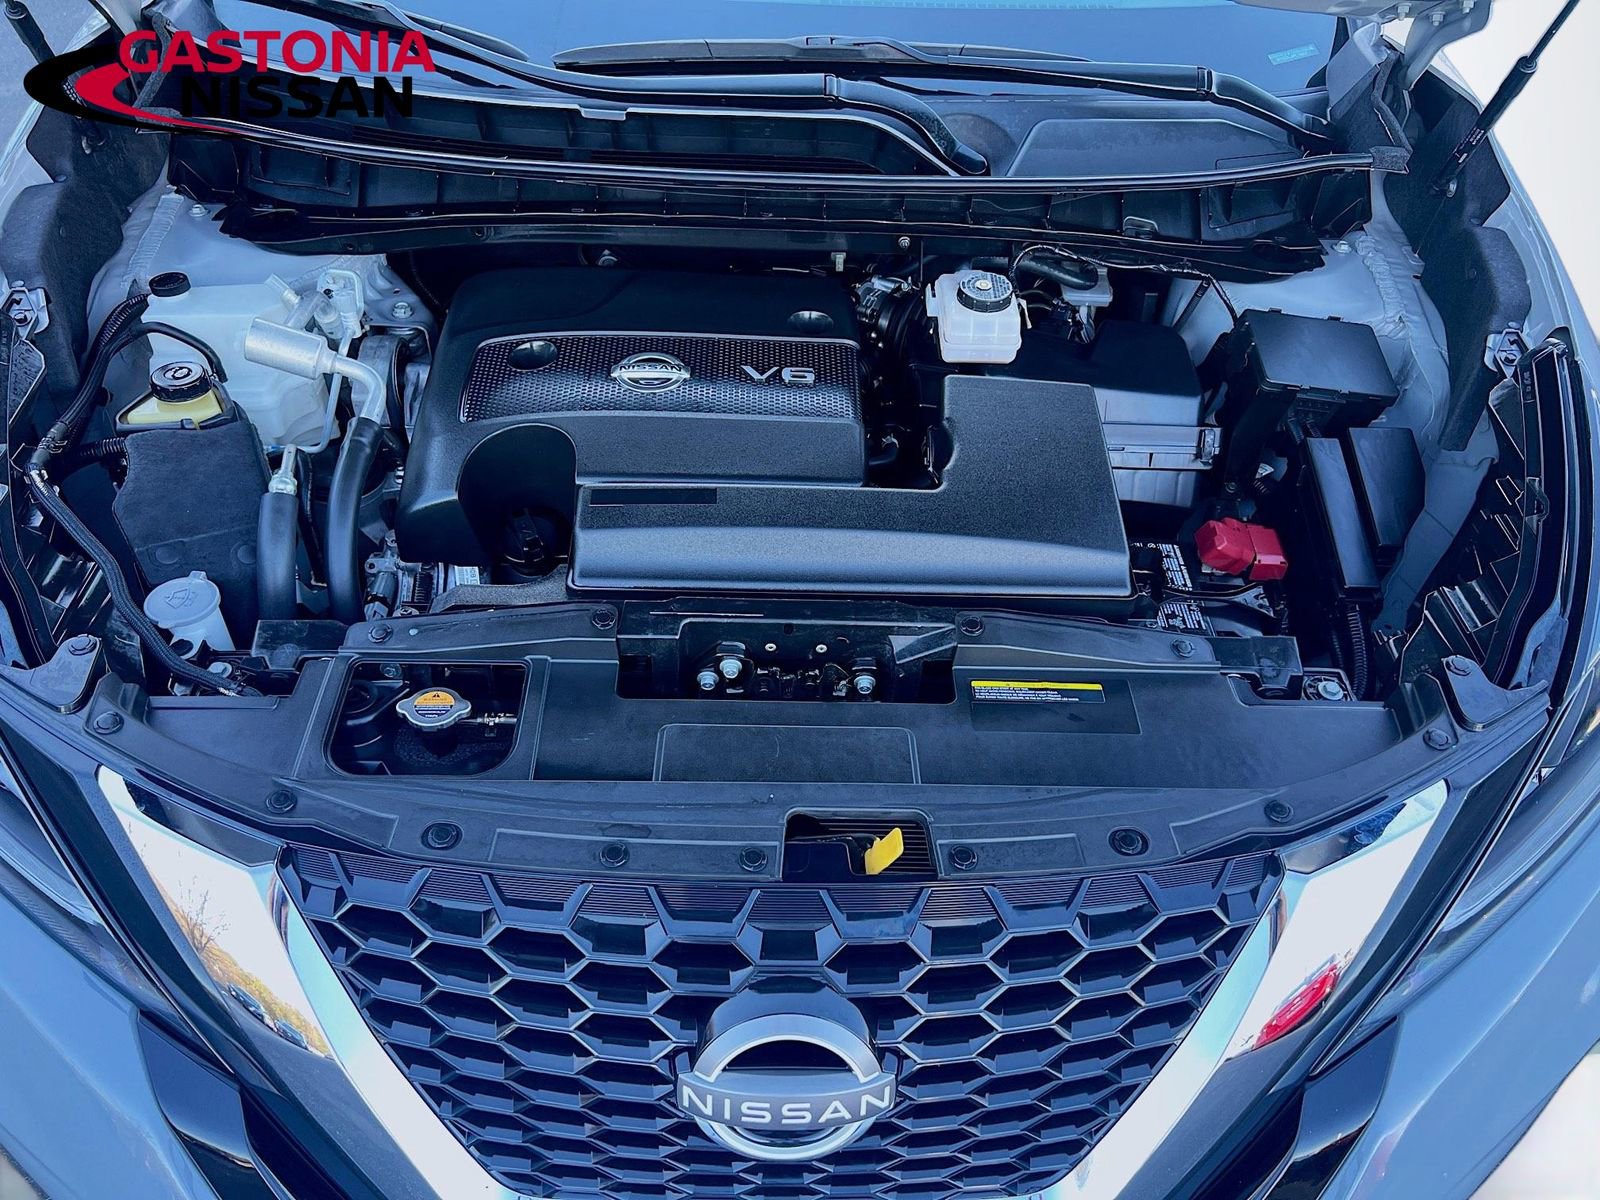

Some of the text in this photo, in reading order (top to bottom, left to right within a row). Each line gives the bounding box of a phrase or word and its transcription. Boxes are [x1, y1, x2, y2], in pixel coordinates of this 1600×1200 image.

[619, 364, 682, 373] NISSAN
[740, 365, 816, 384] V6
[682, 1085, 891, 1124] NISSAN
